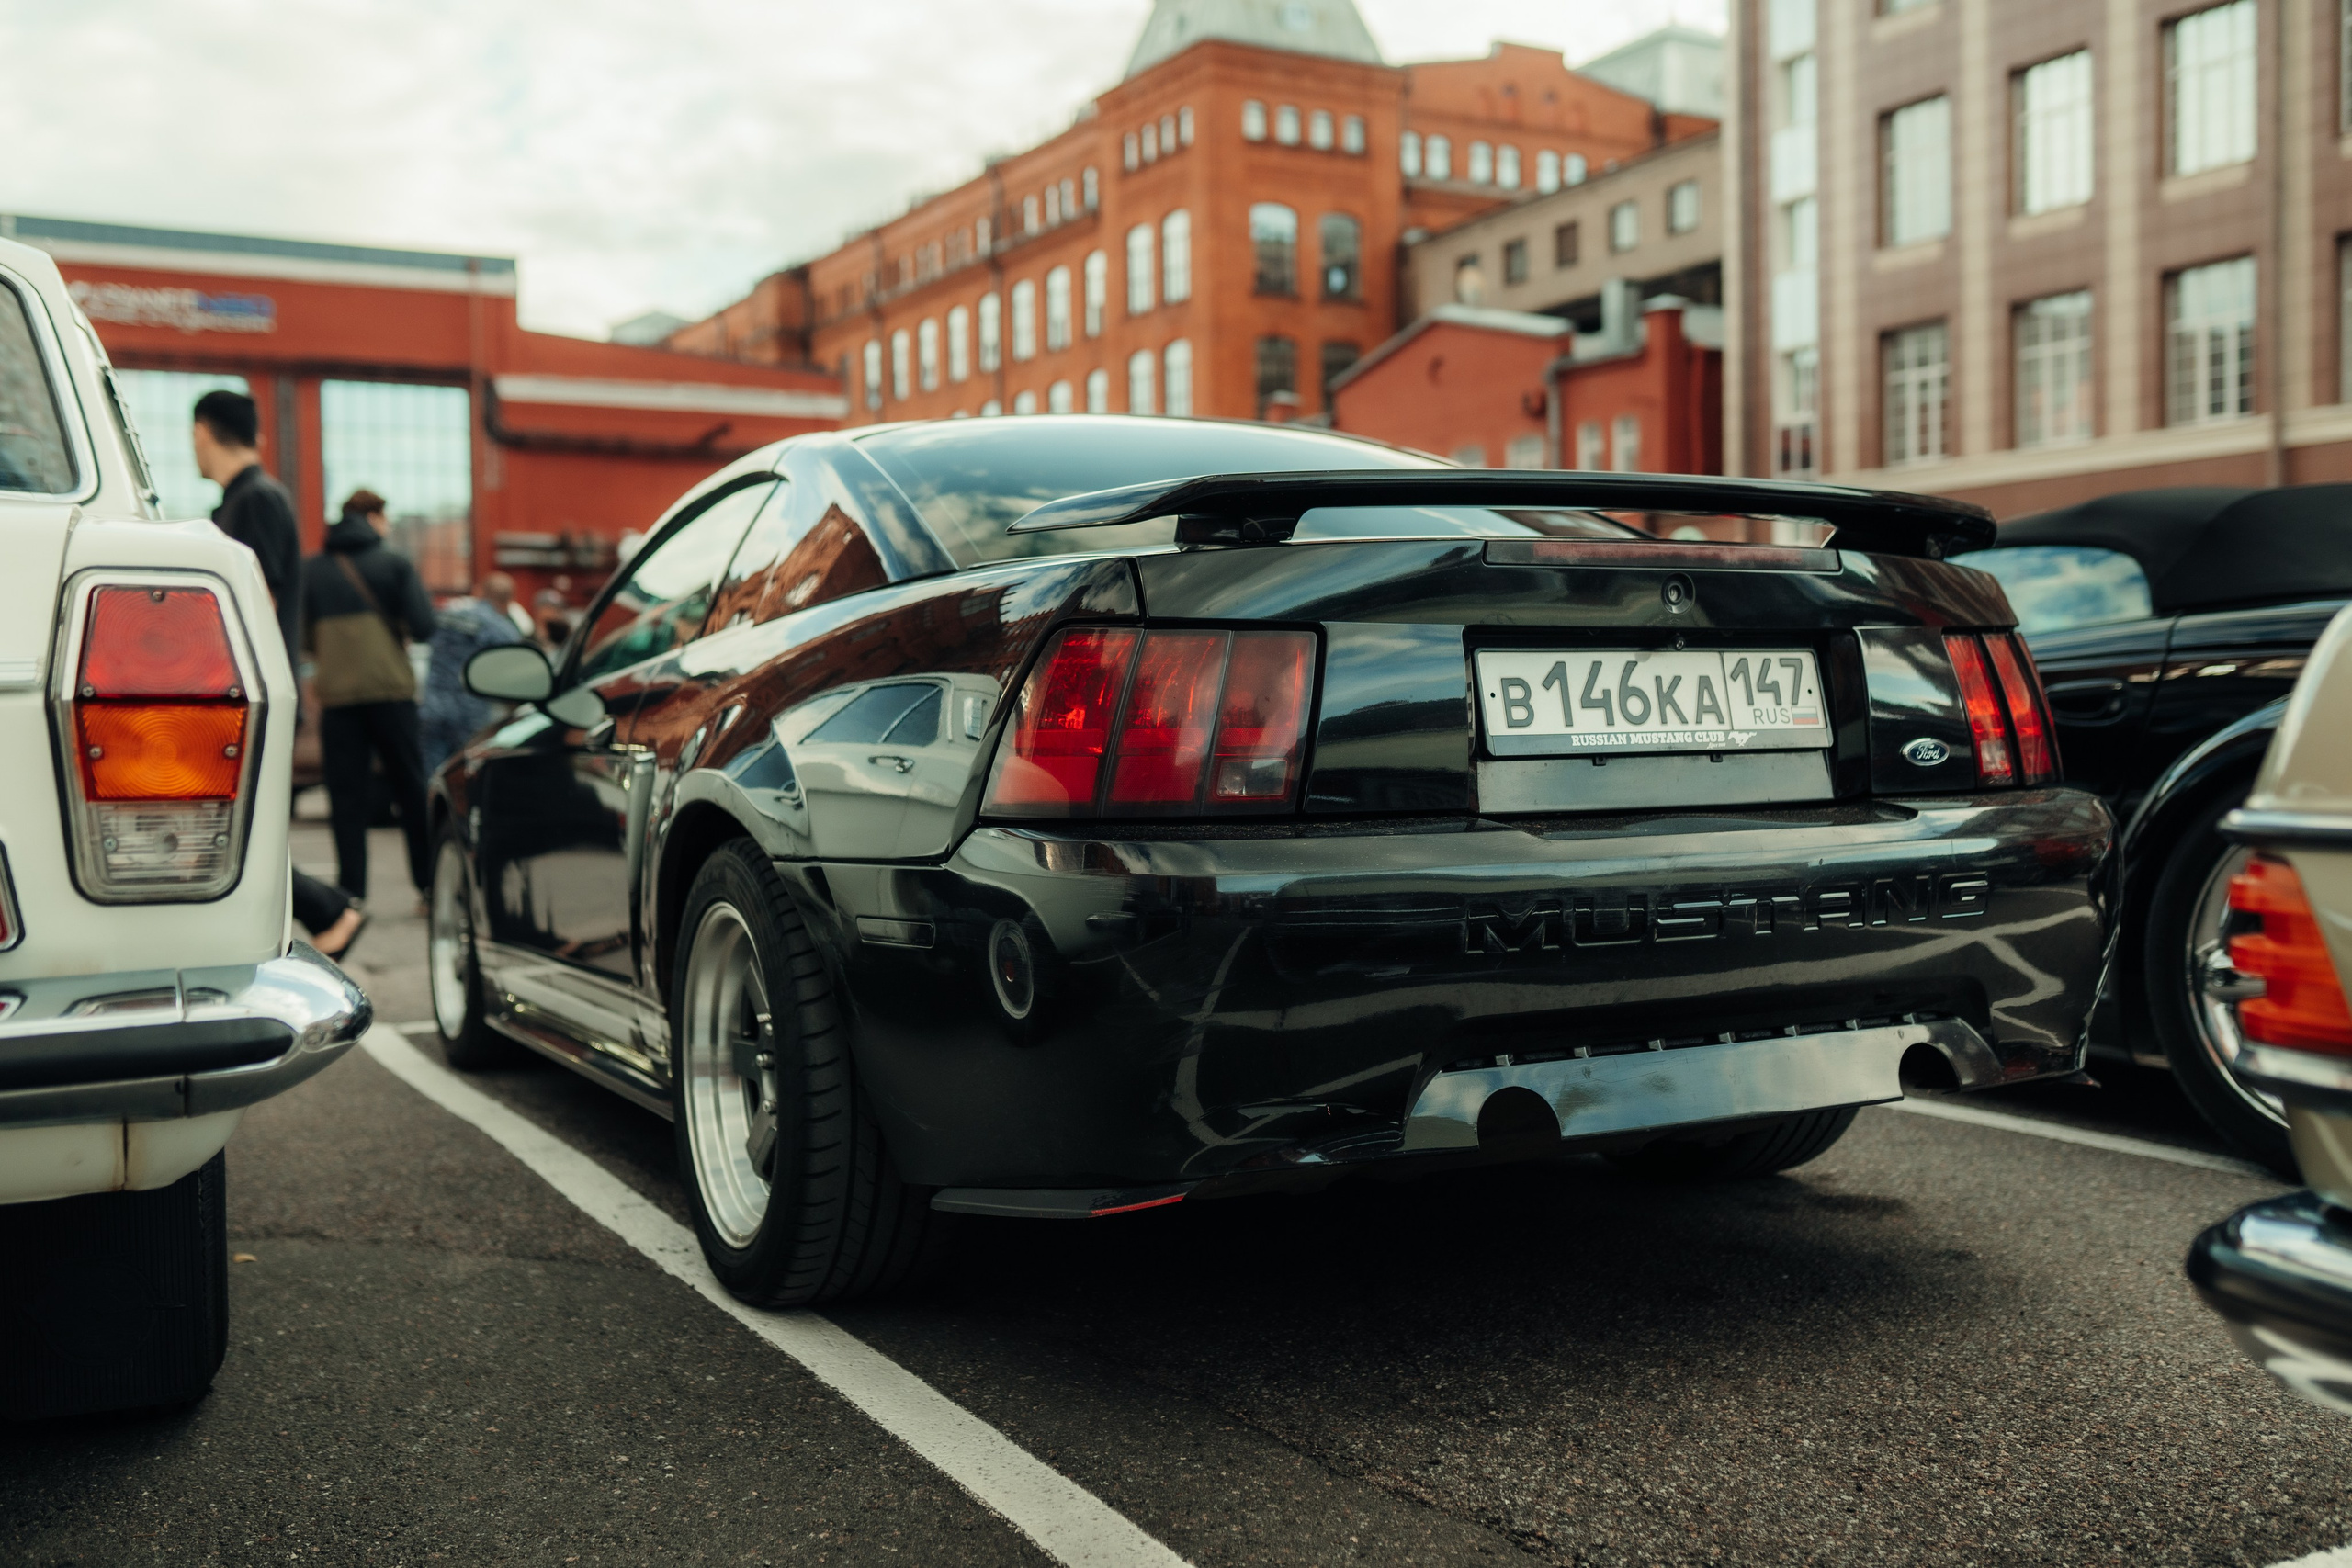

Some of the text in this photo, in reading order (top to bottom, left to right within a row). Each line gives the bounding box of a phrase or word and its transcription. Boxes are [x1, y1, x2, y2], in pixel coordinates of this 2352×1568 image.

[1731, 658, 1803, 705] 147
[1754, 707, 1791, 725] RUS
[1572, 731, 1725, 747] RUSSIAN MUSTANG CLUB
[1916, 742, 1940, 760] Ford
[1465, 871, 1988, 954] MUSTANG
